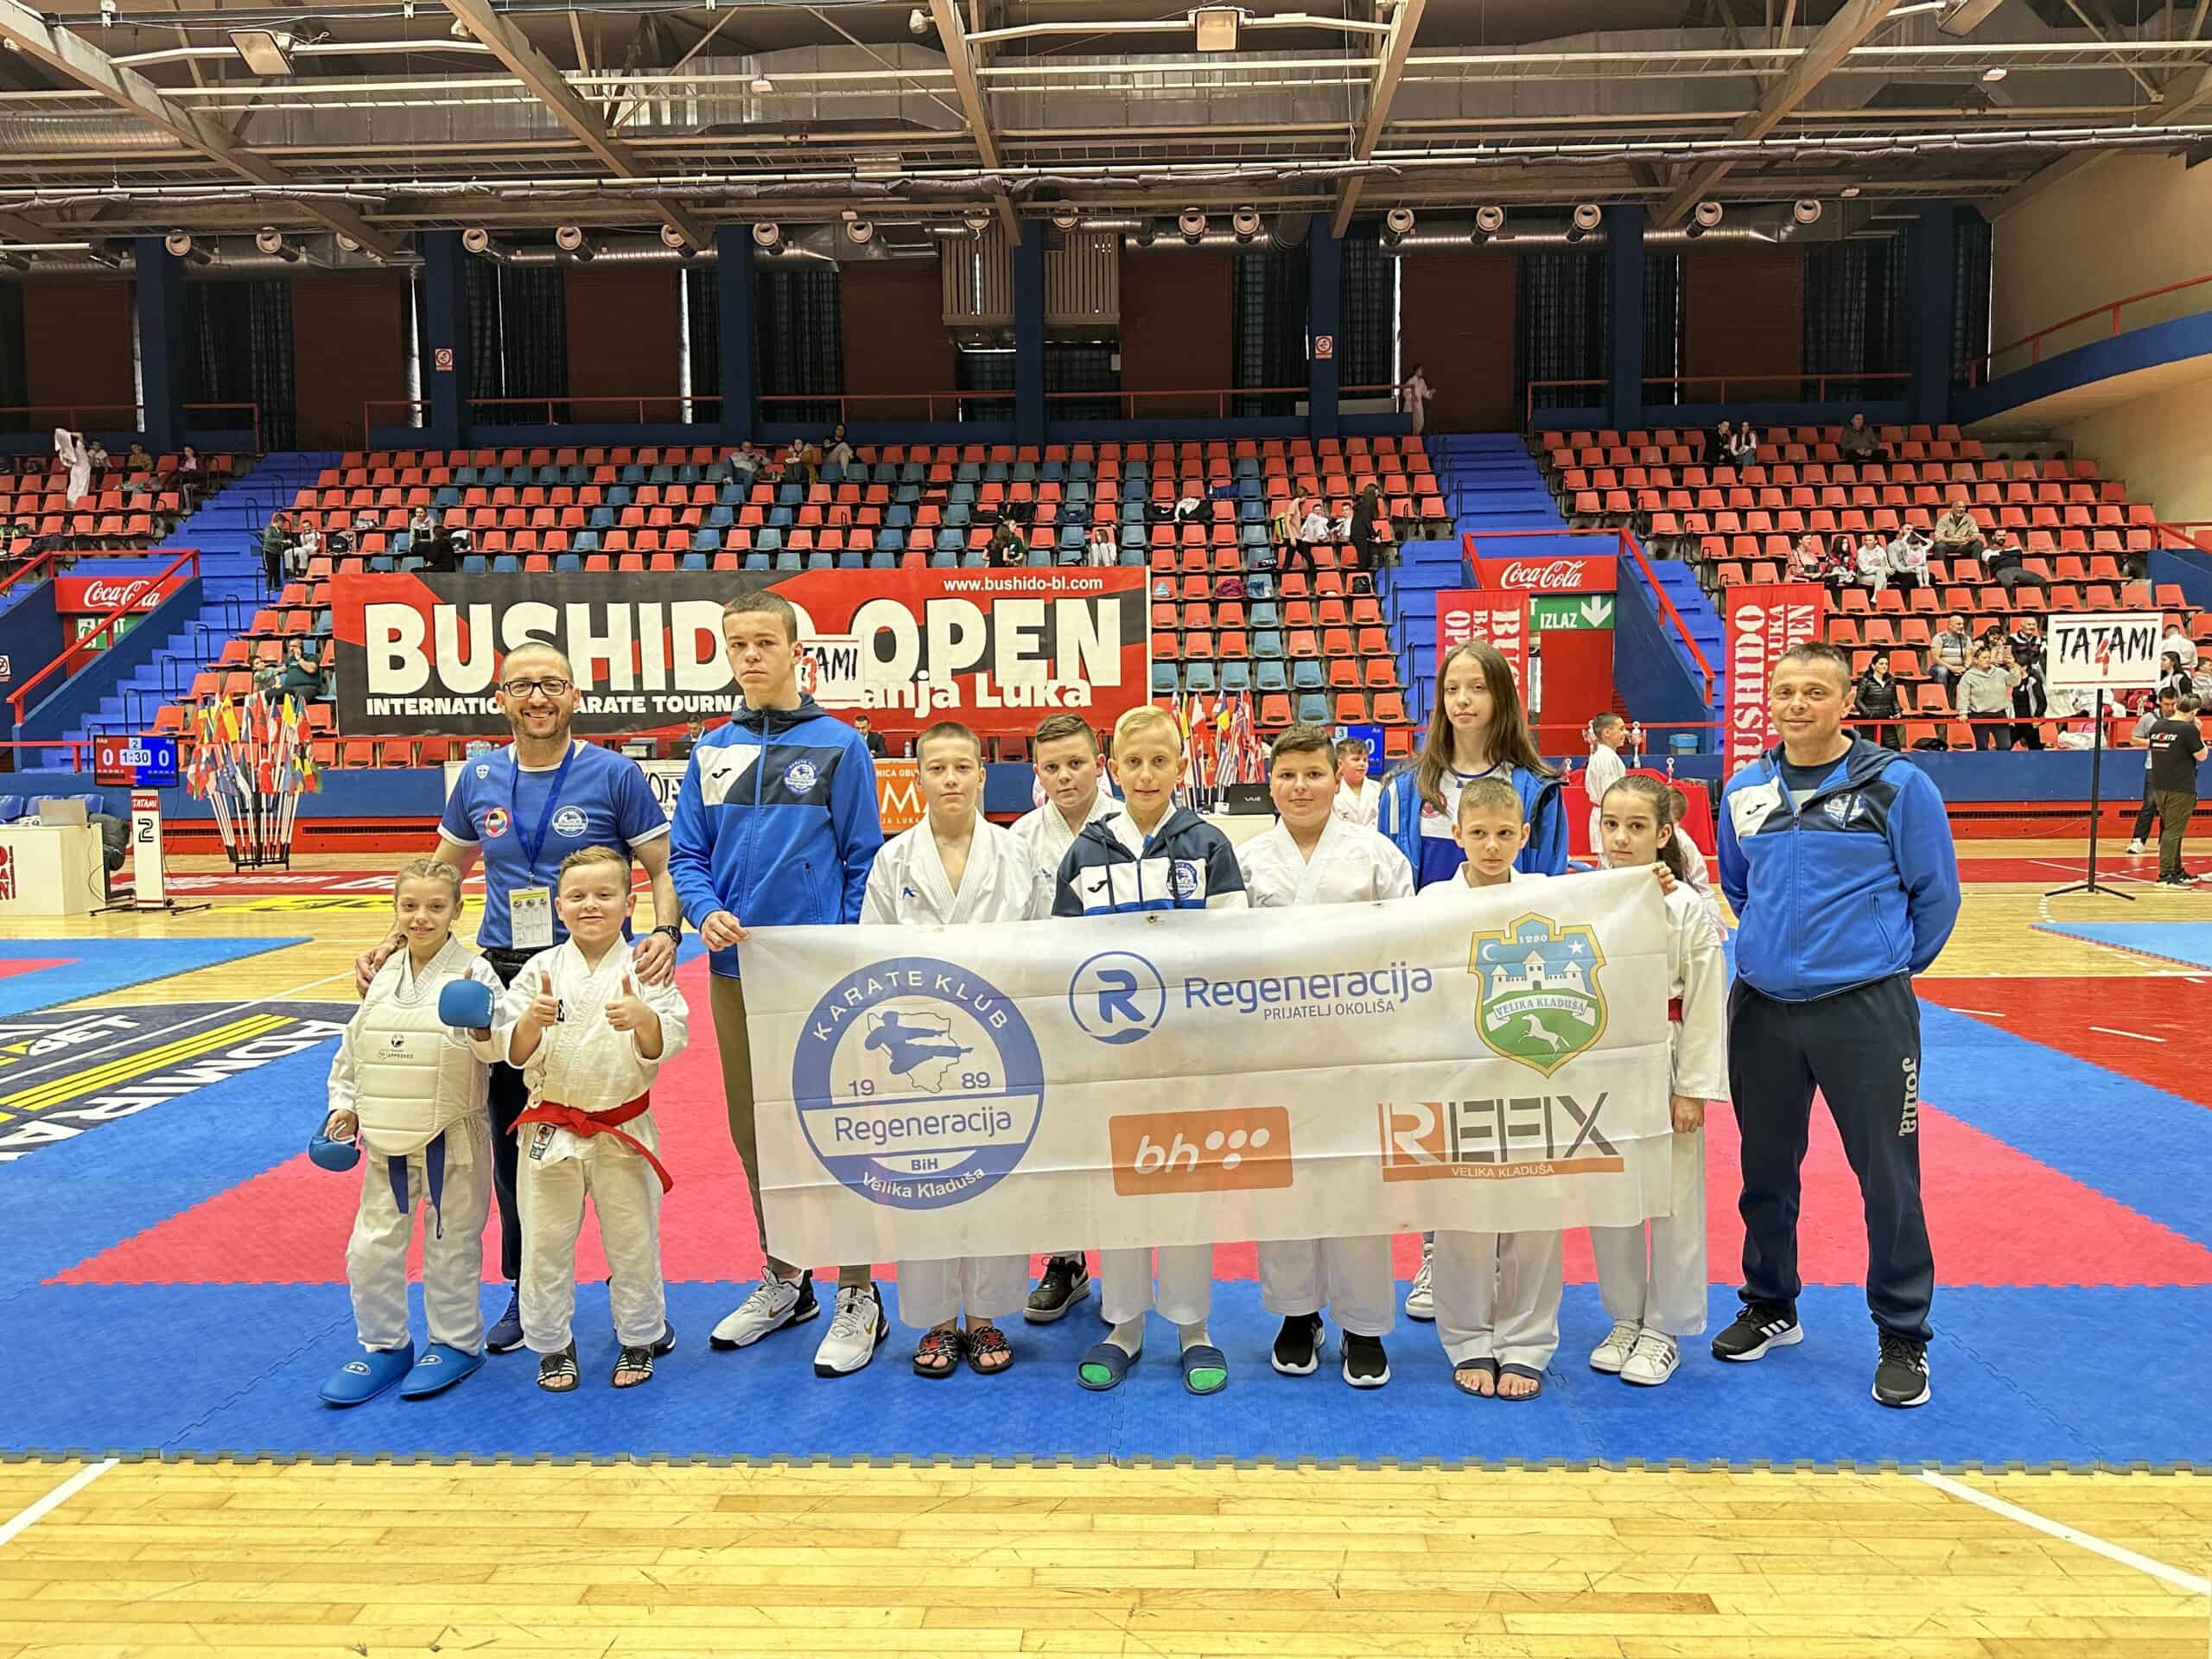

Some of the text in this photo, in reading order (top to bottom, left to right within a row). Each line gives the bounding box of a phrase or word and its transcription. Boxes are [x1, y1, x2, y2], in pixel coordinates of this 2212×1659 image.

[944, 576, 1103, 591] www.bushido-bl.com
[1501, 560, 1587, 589] Coca-Cola
[1540, 613, 1578, 629] IZLAZ
[365, 598, 1121, 694] BUSHID OPEN
[2055, 626, 2157, 665] TATAMI
[2094, 639, 2110, 677] 4
[366, 695, 745, 715] INTERNATIO ARATE TOURNA
[862, 671, 1092, 718] anja Luka
[131, 740, 138, 748] 2
[102, 748, 169, 767] 0 1:30 0
[132, 799, 157, 808] TATAMI
[138, 818, 155, 843] 2
[1184, 961, 1433, 1014] Regeneracija
[813, 970, 1008, 1041] KARATE KLUB
[1264, 999, 1395, 1020] PRIJATELJ OKOLIŠA
[1495, 997, 1584, 1016] VELIKA KLADUŠA
[848, 1071, 991, 1096] 19 89
[1897, 1056, 1918, 1137] Joma
[834, 1106, 1012, 1147] Regeneracija
[911, 1158, 938, 1171] BiH
[1452, 1164, 1554, 1179] VELIKA KLADUŠA
[862, 1166, 985, 1198] Velika Kladuša
